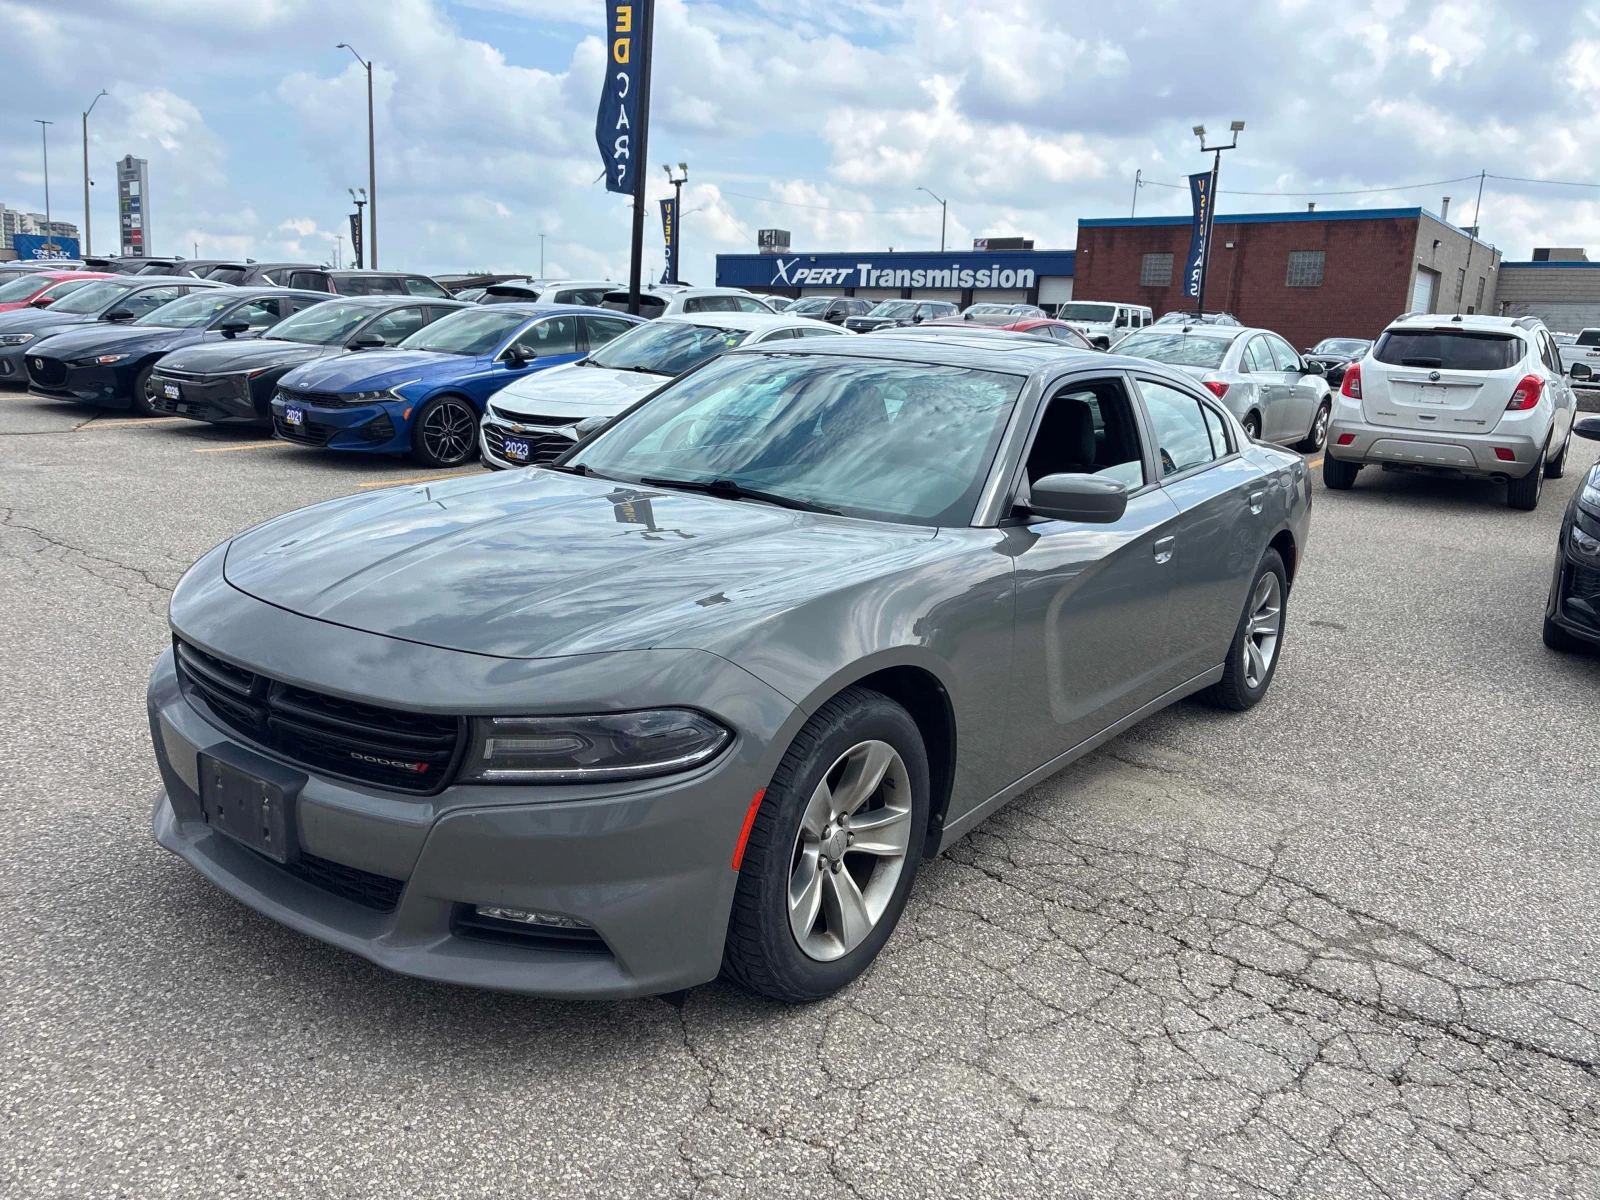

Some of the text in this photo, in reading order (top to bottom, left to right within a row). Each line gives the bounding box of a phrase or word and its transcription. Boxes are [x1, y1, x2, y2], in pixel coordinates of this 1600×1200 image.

[770, 257, 1035, 289] XPERT Transmission
[286, 409, 302, 422] 2021
[505, 441, 528, 456] 2023
[350, 752, 419, 771] DODGE
